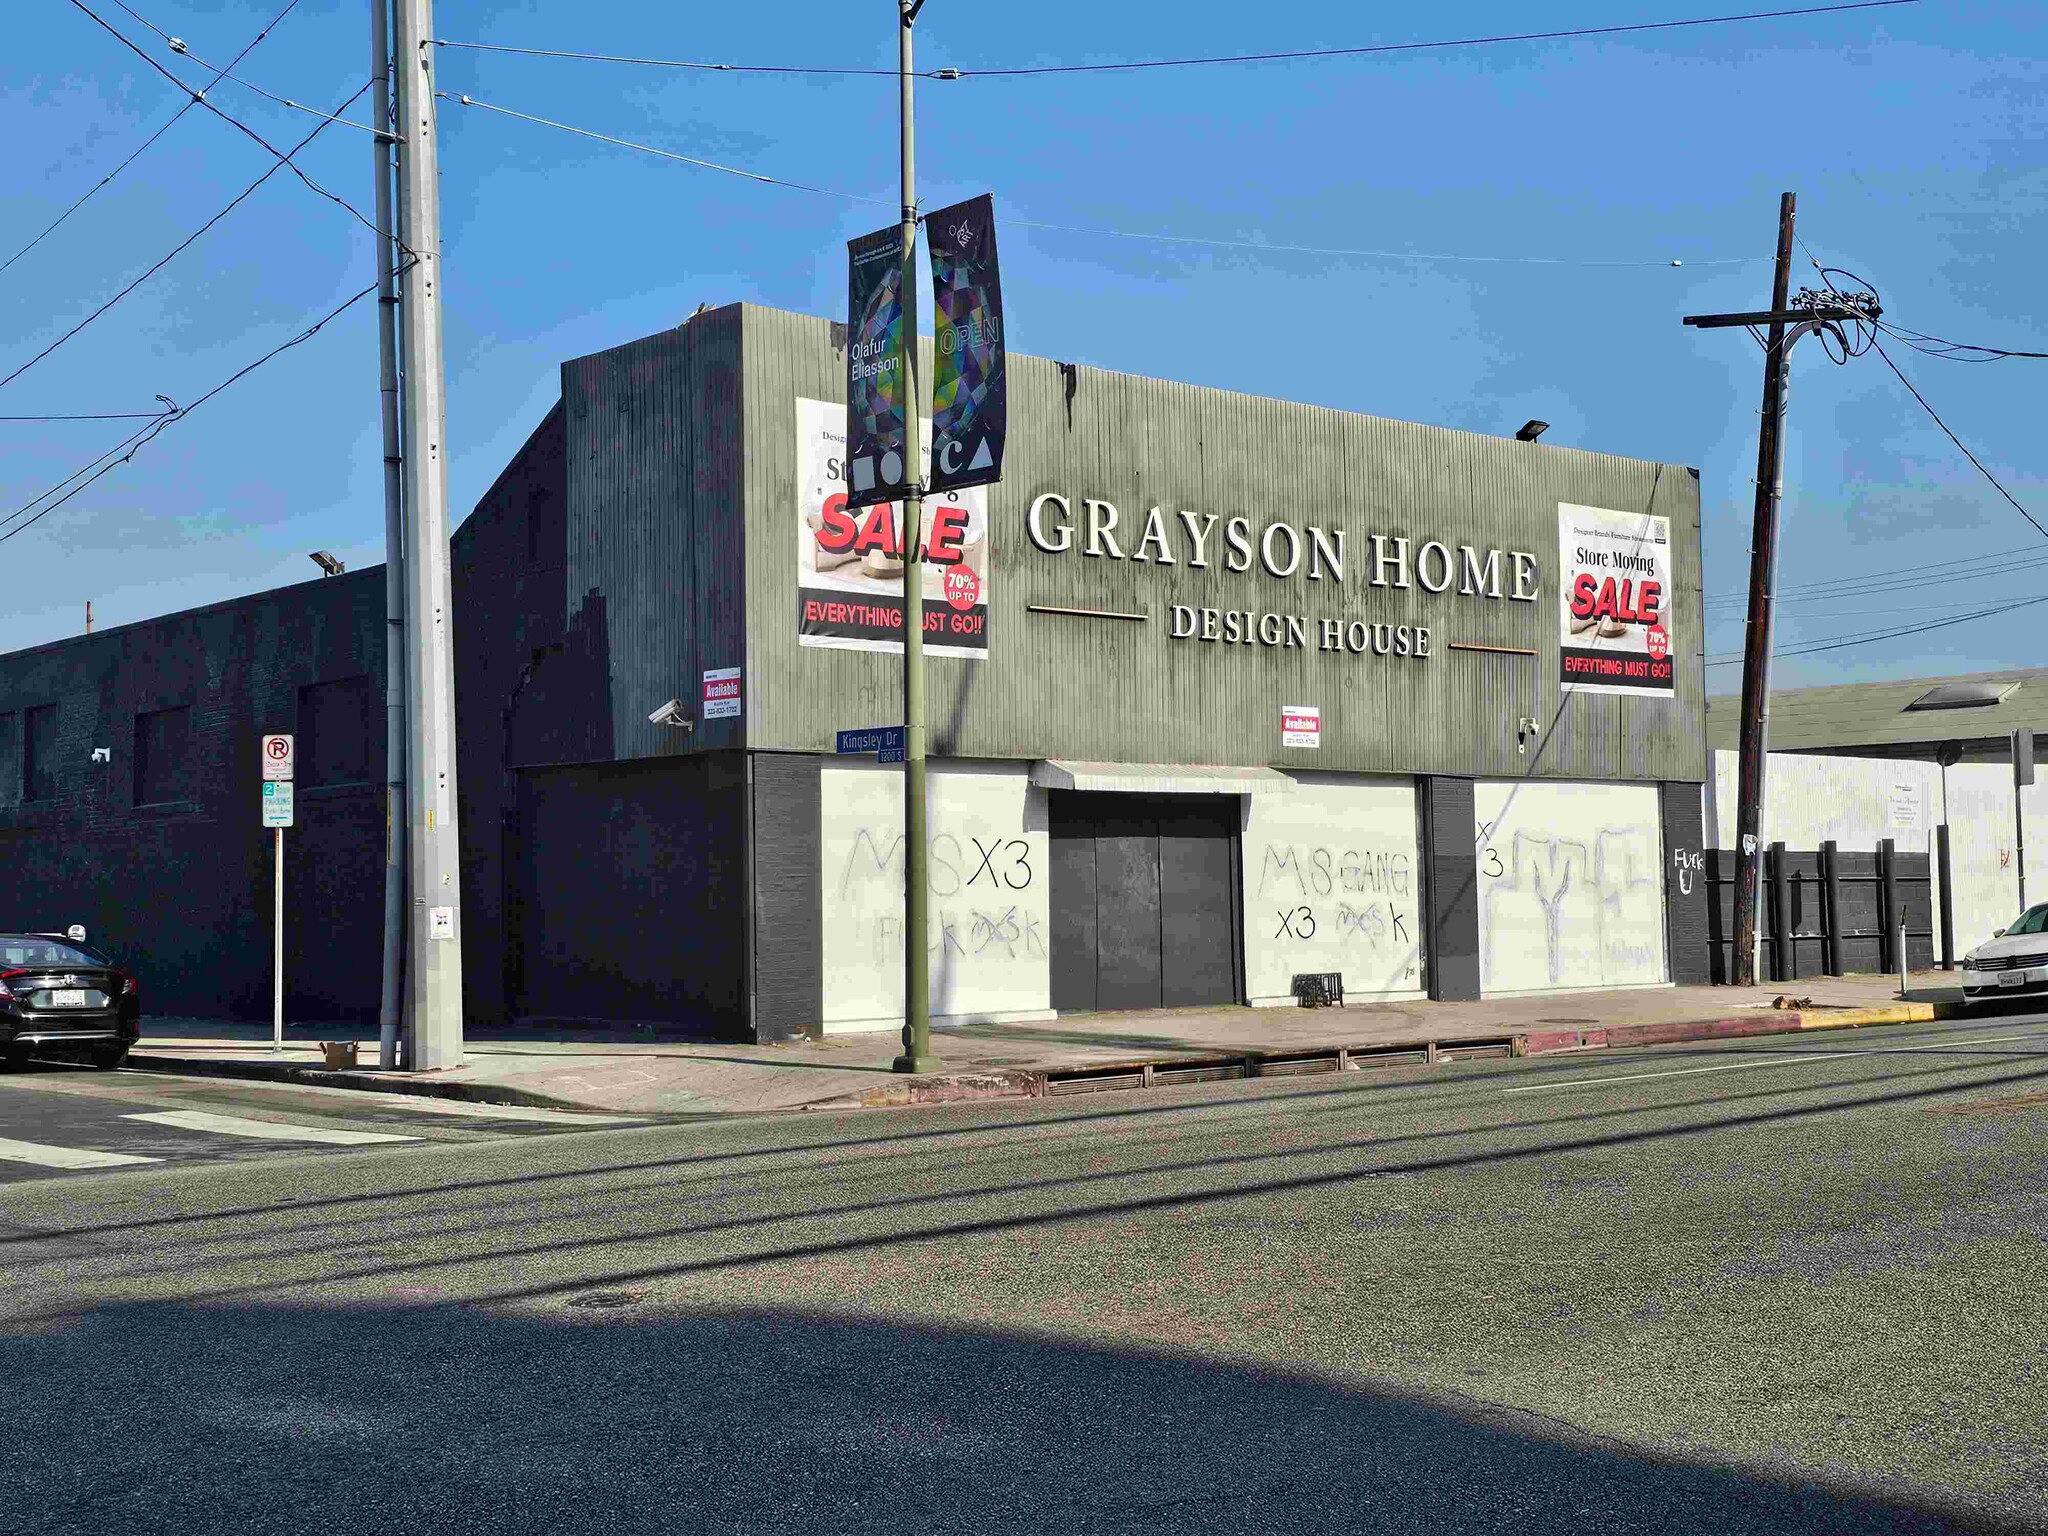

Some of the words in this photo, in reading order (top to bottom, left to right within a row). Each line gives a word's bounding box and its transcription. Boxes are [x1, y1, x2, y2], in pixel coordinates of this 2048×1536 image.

[941, 316, 999, 354] OPEN
[852, 339, 886, 361] Olafur
[852, 356, 899, 381] Eliasson
[1027, 493, 1346, 583] GRAYSON
[1368, 534, 1539, 602] HOME
[1576, 546, 1609, 568] Store
[1612, 551, 1655, 577] Moving
[948, 573, 975, 590] 70%
[949, 591, 962, 601] UP
[963, 592, 975, 602] TO
[1569, 573, 1662, 626] SALE
[805, 601, 902, 628] EVERYTHING
[920, 611, 946, 632] UST
[950, 614, 983, 635] GO!!
[1171, 604, 1308, 648] DESIGN
[1319, 618, 1432, 657] HOUSE
[1649, 631, 1666, 645] 70%
[1565, 656, 1623, 675] EVERYTHING
[1625, 660, 1649, 677] MUST
[1651, 662, 1671, 678] GO!!
[706, 682, 738, 697] Available
[842, 733, 882, 752] Kingsley
[886, 731, 898, 746] Dr
[881, 751, 896, 762] 1200
[897, 751, 902, 761] S
[265, 784, 274, 796] 2
[1340, 849, 1409, 898] GANG
[1274, 906, 1316, 939] X3
